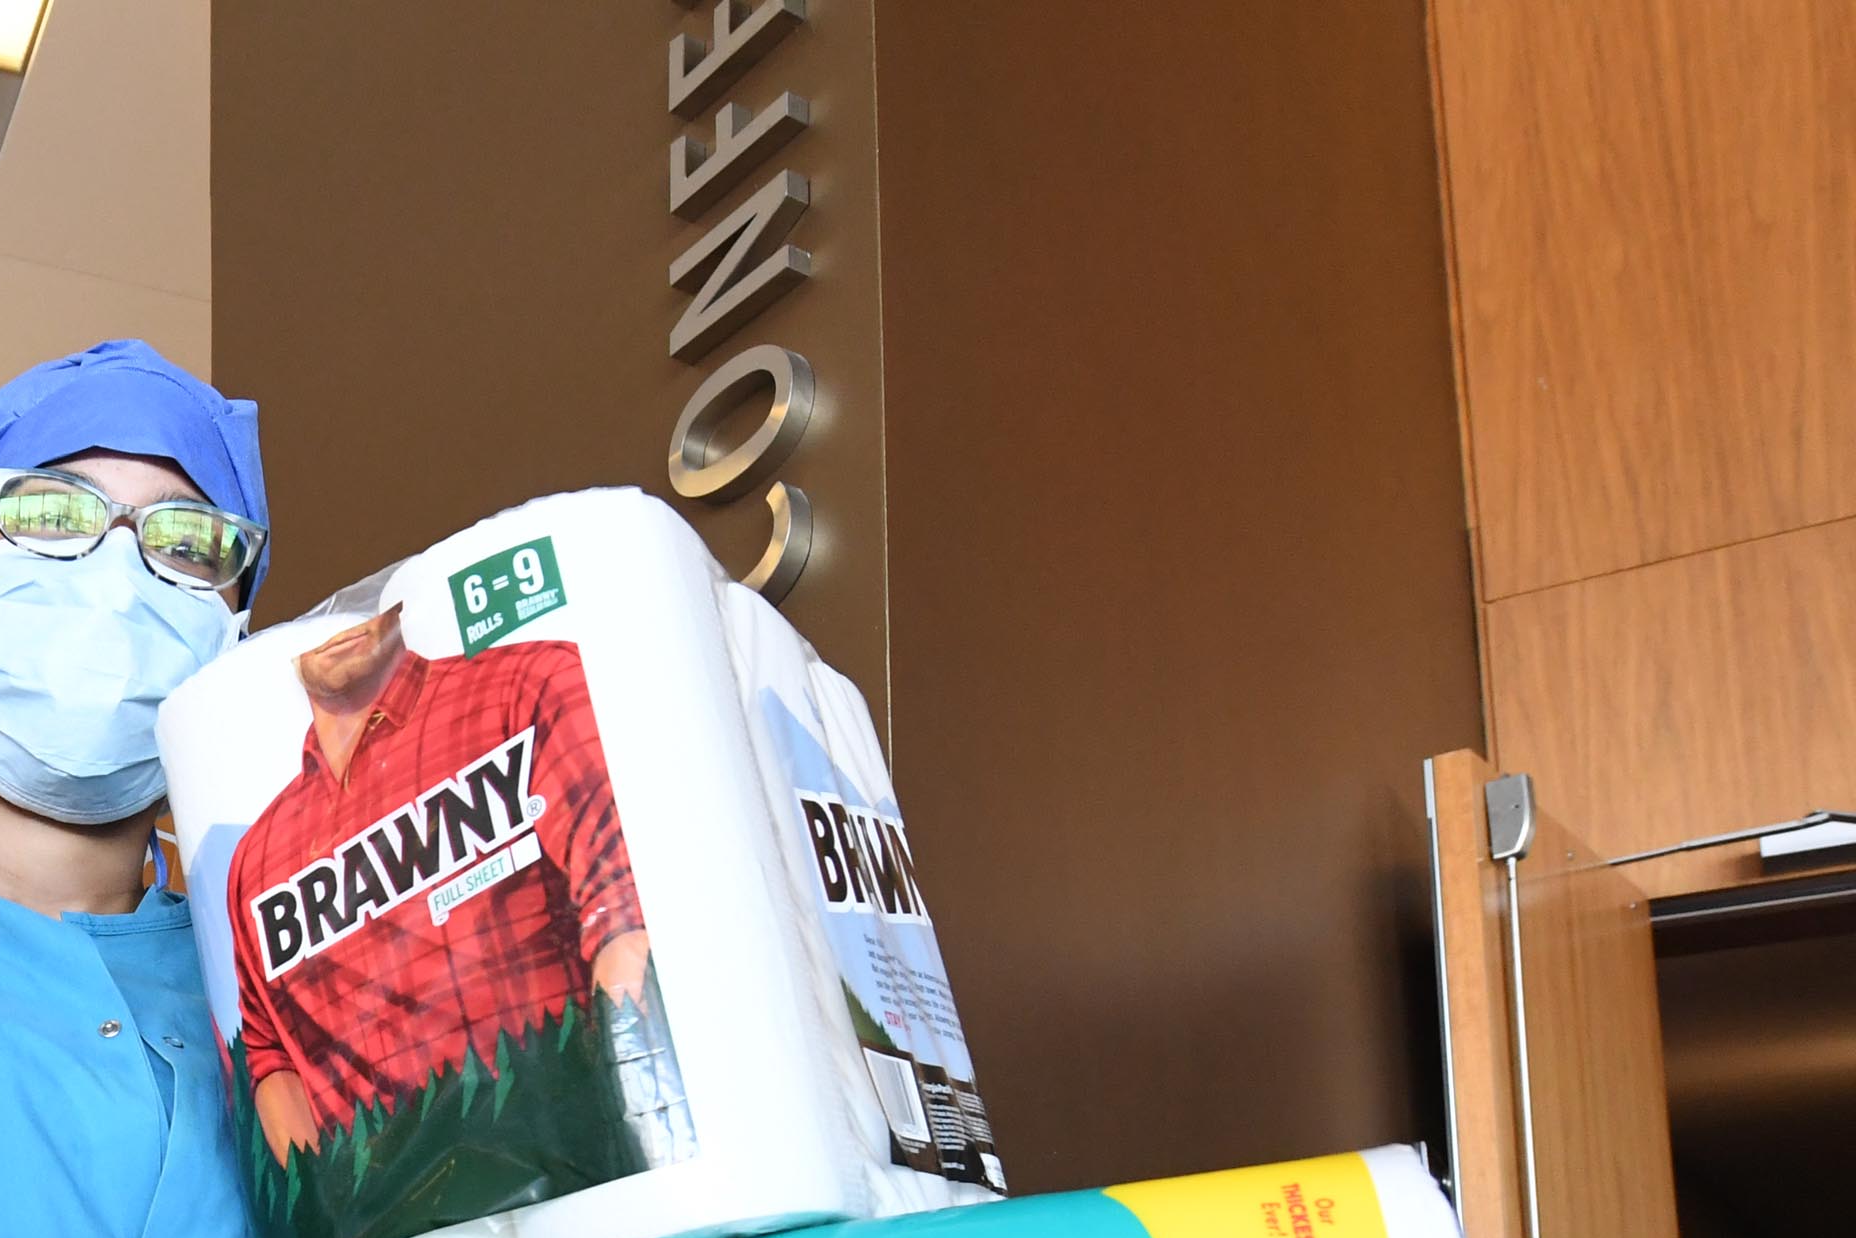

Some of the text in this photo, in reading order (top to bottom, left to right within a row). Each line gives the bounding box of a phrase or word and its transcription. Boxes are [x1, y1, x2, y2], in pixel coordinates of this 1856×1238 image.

[463, 574, 489, 614] 6
[512, 547, 545, 594] 9
[466, 610, 504, 646] ROLLS
[256, 738, 534, 971] BRAWNY
[433, 857, 506, 914] FULL SHEET
[1260, 1202, 1289, 1238] Ever!
[1314, 1198, 1335, 1226] Our
